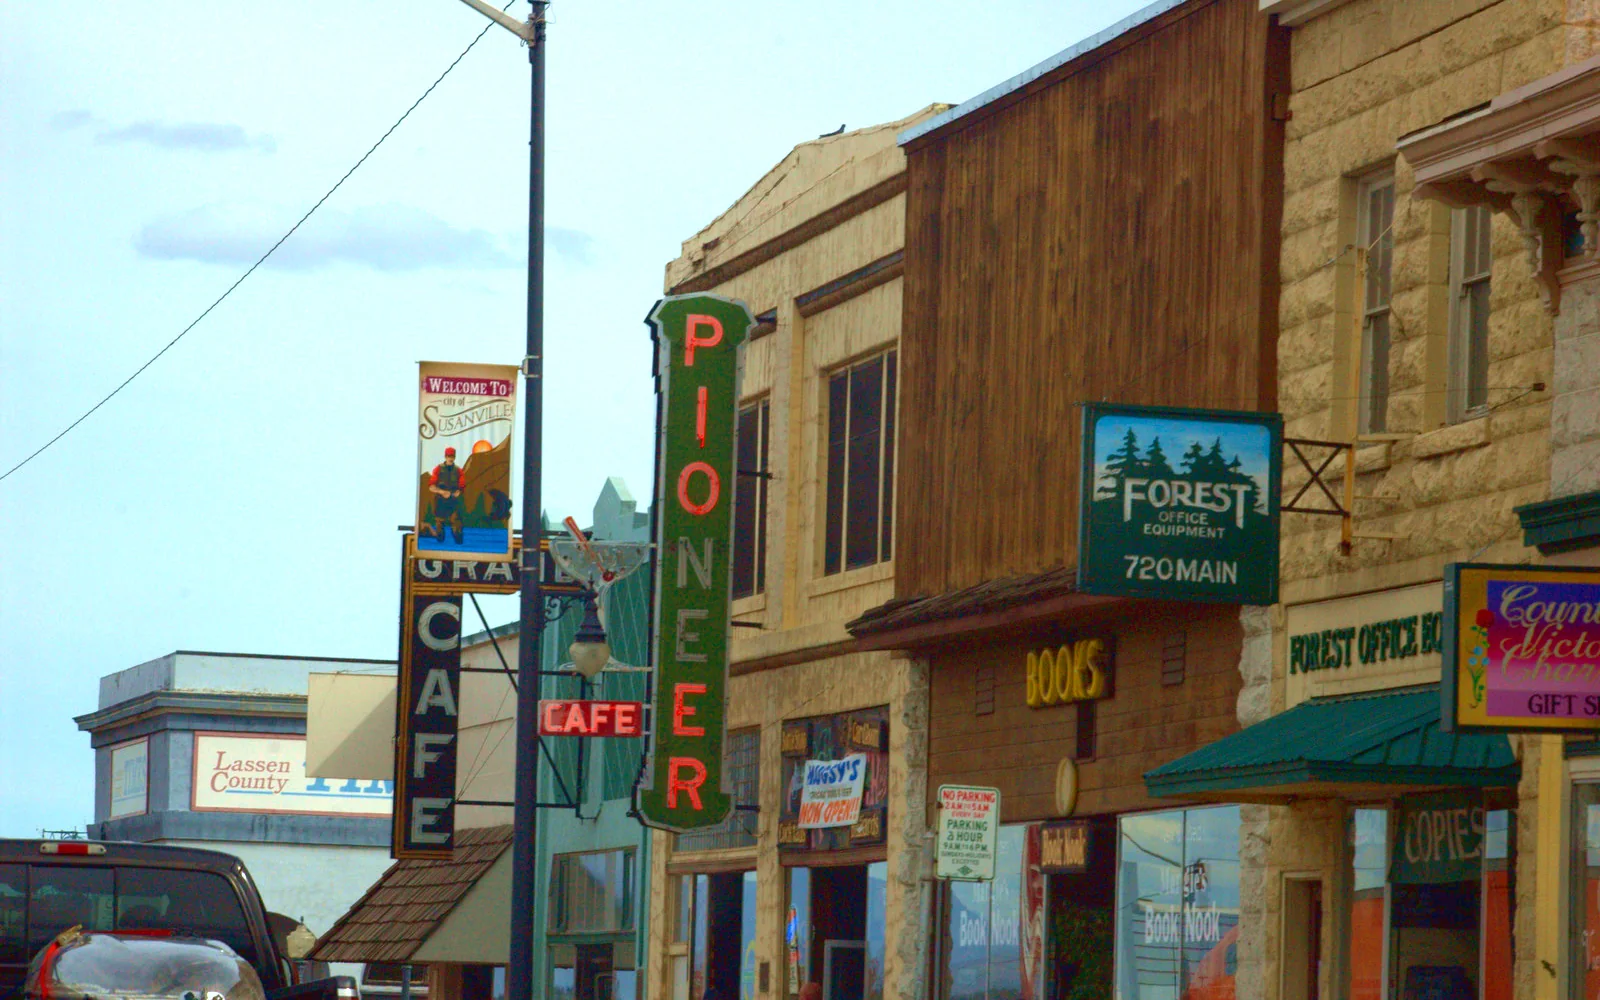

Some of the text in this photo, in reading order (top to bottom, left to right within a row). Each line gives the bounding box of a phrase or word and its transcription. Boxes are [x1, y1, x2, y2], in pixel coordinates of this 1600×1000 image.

[429, 377, 488, 395] WELCOME
[443, 396, 465, 407] city of
[1123, 477, 1252, 530] FOREST
[1143, 523, 1226, 539] EQUIPMENT
[1158, 511, 1209, 526] OFFICE
[418, 550, 583, 583] GRA
[666, 313, 724, 811] PIONEER
[1123, 554, 1238, 585] 720 MAIN
[1289, 626, 1356, 675] FOREST
[1357, 613, 1418, 666] OFFICE
[1026, 638, 1104, 707] BOOKS
[1527, 692, 1577, 716] GIFT
[410, 601, 461, 844] CAFE
[544, 702, 636, 735] CAFE
[213, 750, 291, 774] Lassen
[210, 771, 290, 794] County
[942, 790, 996, 803] NO PARKING
[800, 801, 825, 825] NOW
[947, 819, 988, 832] PARKING
[956, 832, 983, 843] HOUR
[1404, 806, 1484, 864] COPIES
[959, 909, 1020, 948] Book Nook
[1144, 900, 1221, 943] Book Nook
